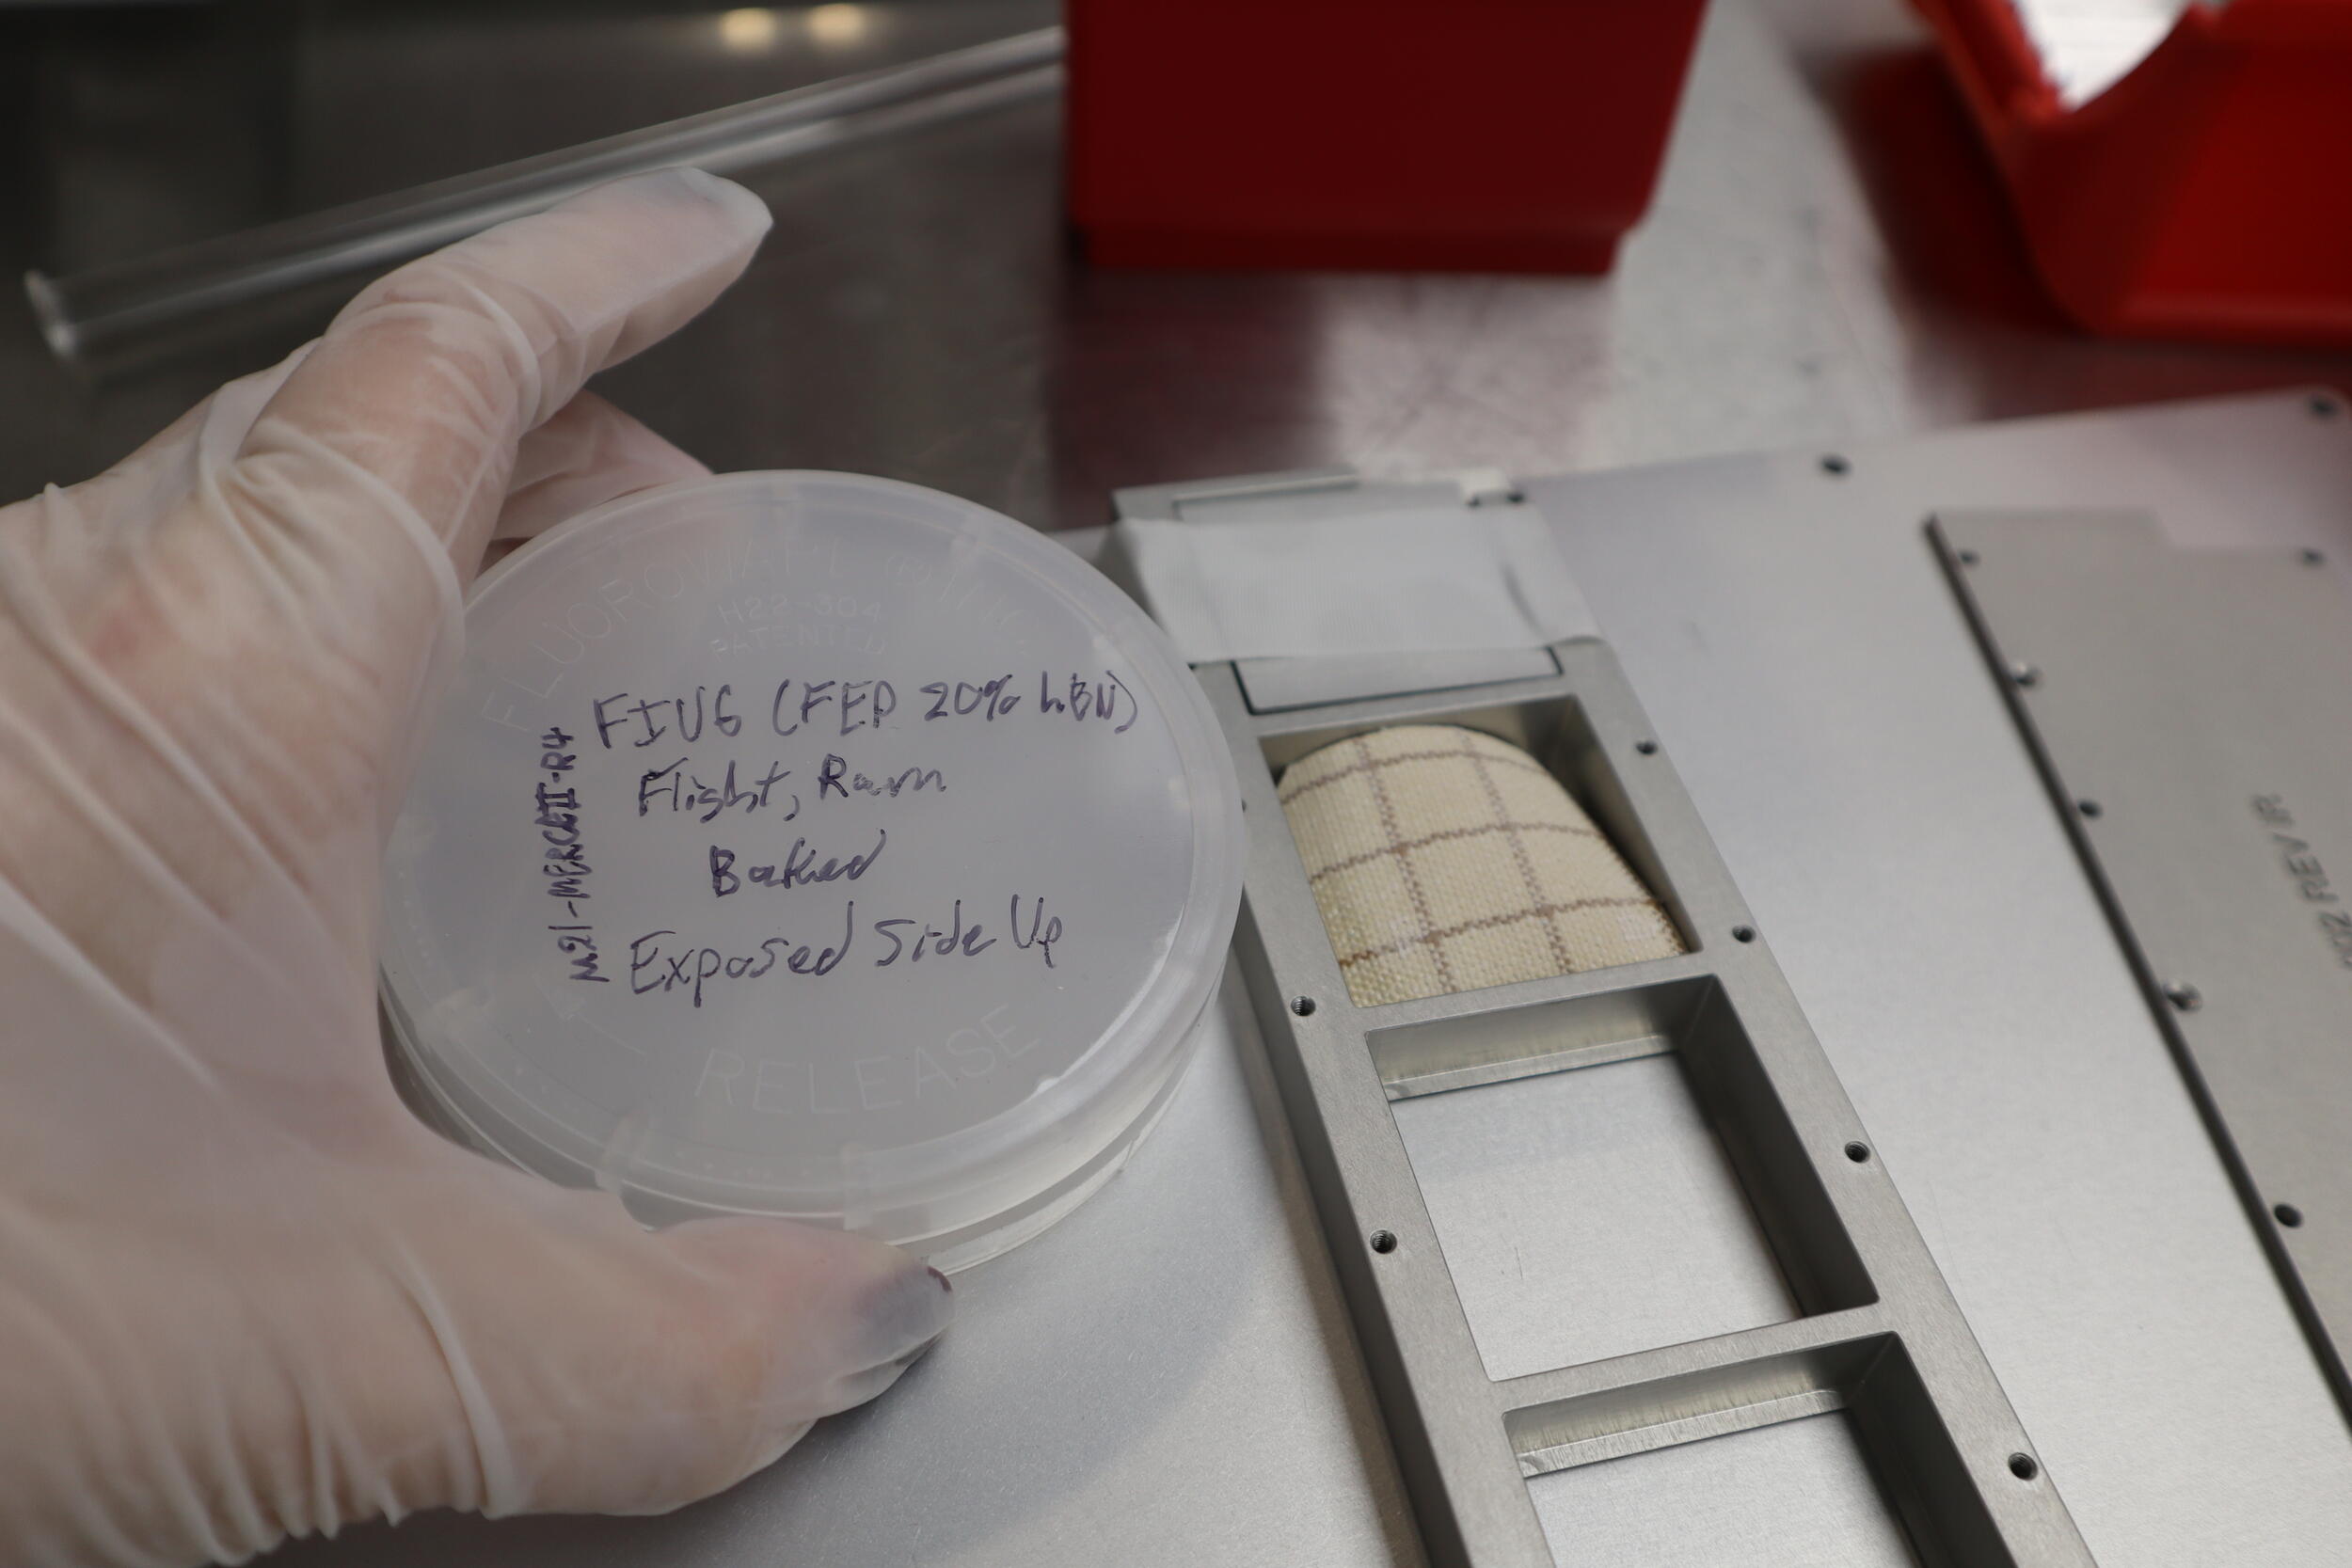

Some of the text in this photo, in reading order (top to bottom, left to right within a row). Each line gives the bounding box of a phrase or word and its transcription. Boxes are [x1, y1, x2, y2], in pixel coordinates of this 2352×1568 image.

[707, 621, 887, 663] PATENTED
[771, 678, 898, 737] (FEP
[919, 673, 1023, 722] 20%
[637, 752, 947, 824] Flight, Ram
[708, 828, 887, 899] Baked
[628, 893, 1063, 1010] Exposed Side Up
[693, 1003, 1041, 1116] RELEASE
